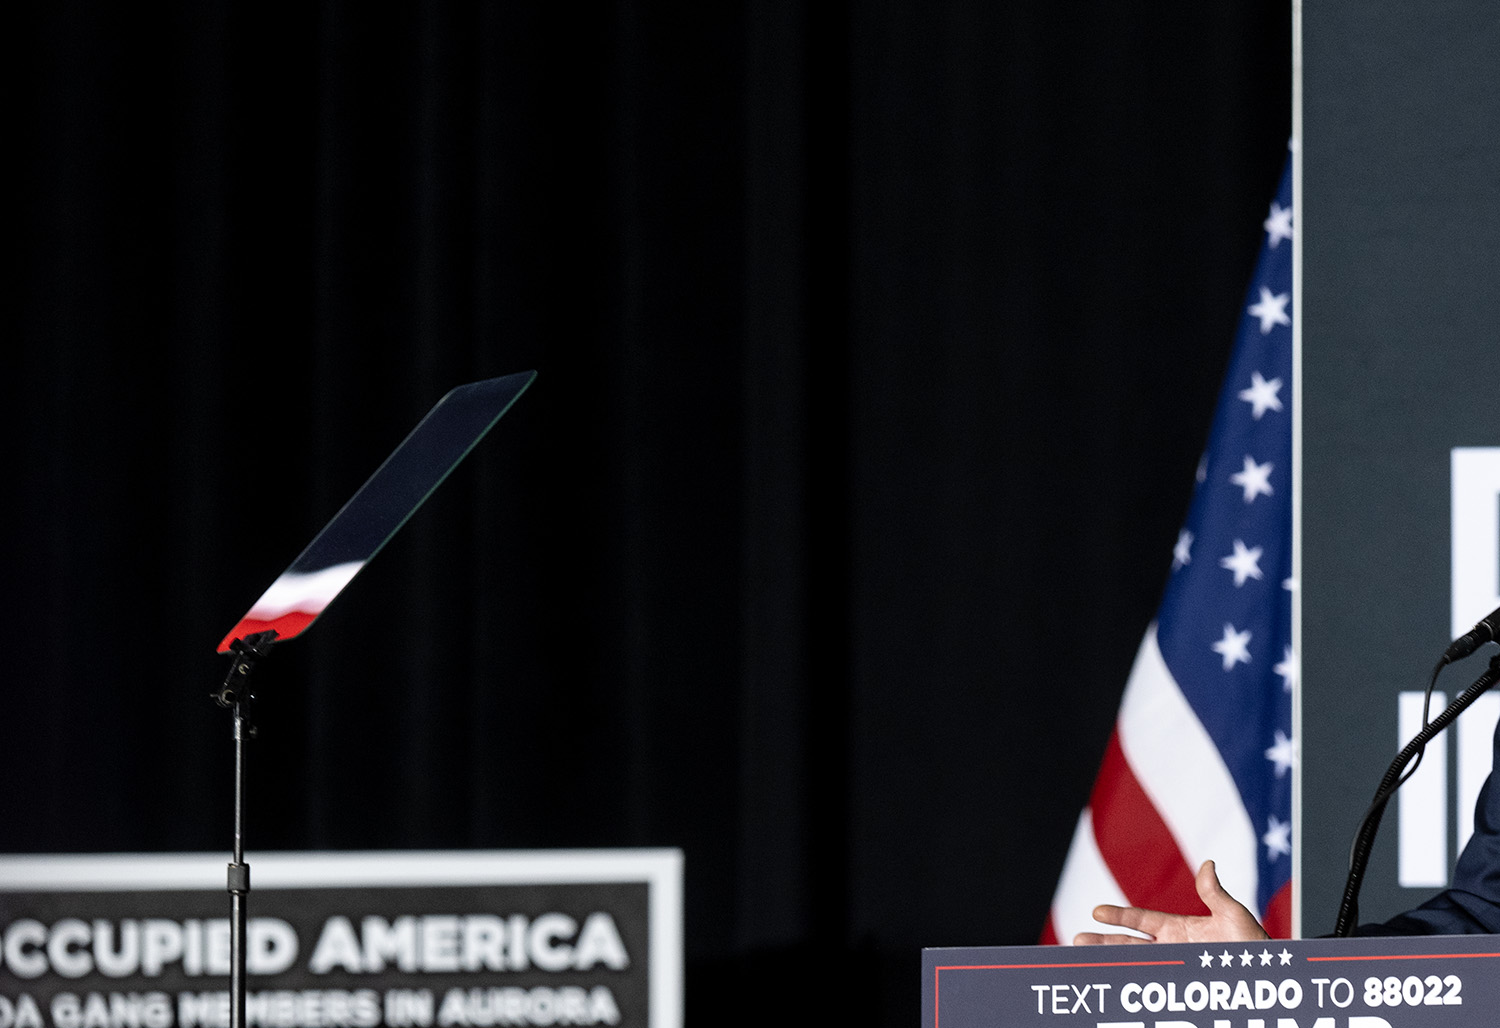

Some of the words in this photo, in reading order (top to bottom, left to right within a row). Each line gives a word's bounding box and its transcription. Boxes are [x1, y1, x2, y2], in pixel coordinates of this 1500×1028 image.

[0, 917, 299, 979] CCUPIED
[309, 911, 632, 975] AMERICA
[386, 989, 433, 1028] IN
[437, 985, 622, 1027] AURORA
[1031, 983, 1111, 1015] TEXT
[1120, 978, 1303, 1013] COLORADO
[1311, 977, 1353, 1008] TO
[1363, 975, 1462, 1006] 88022
